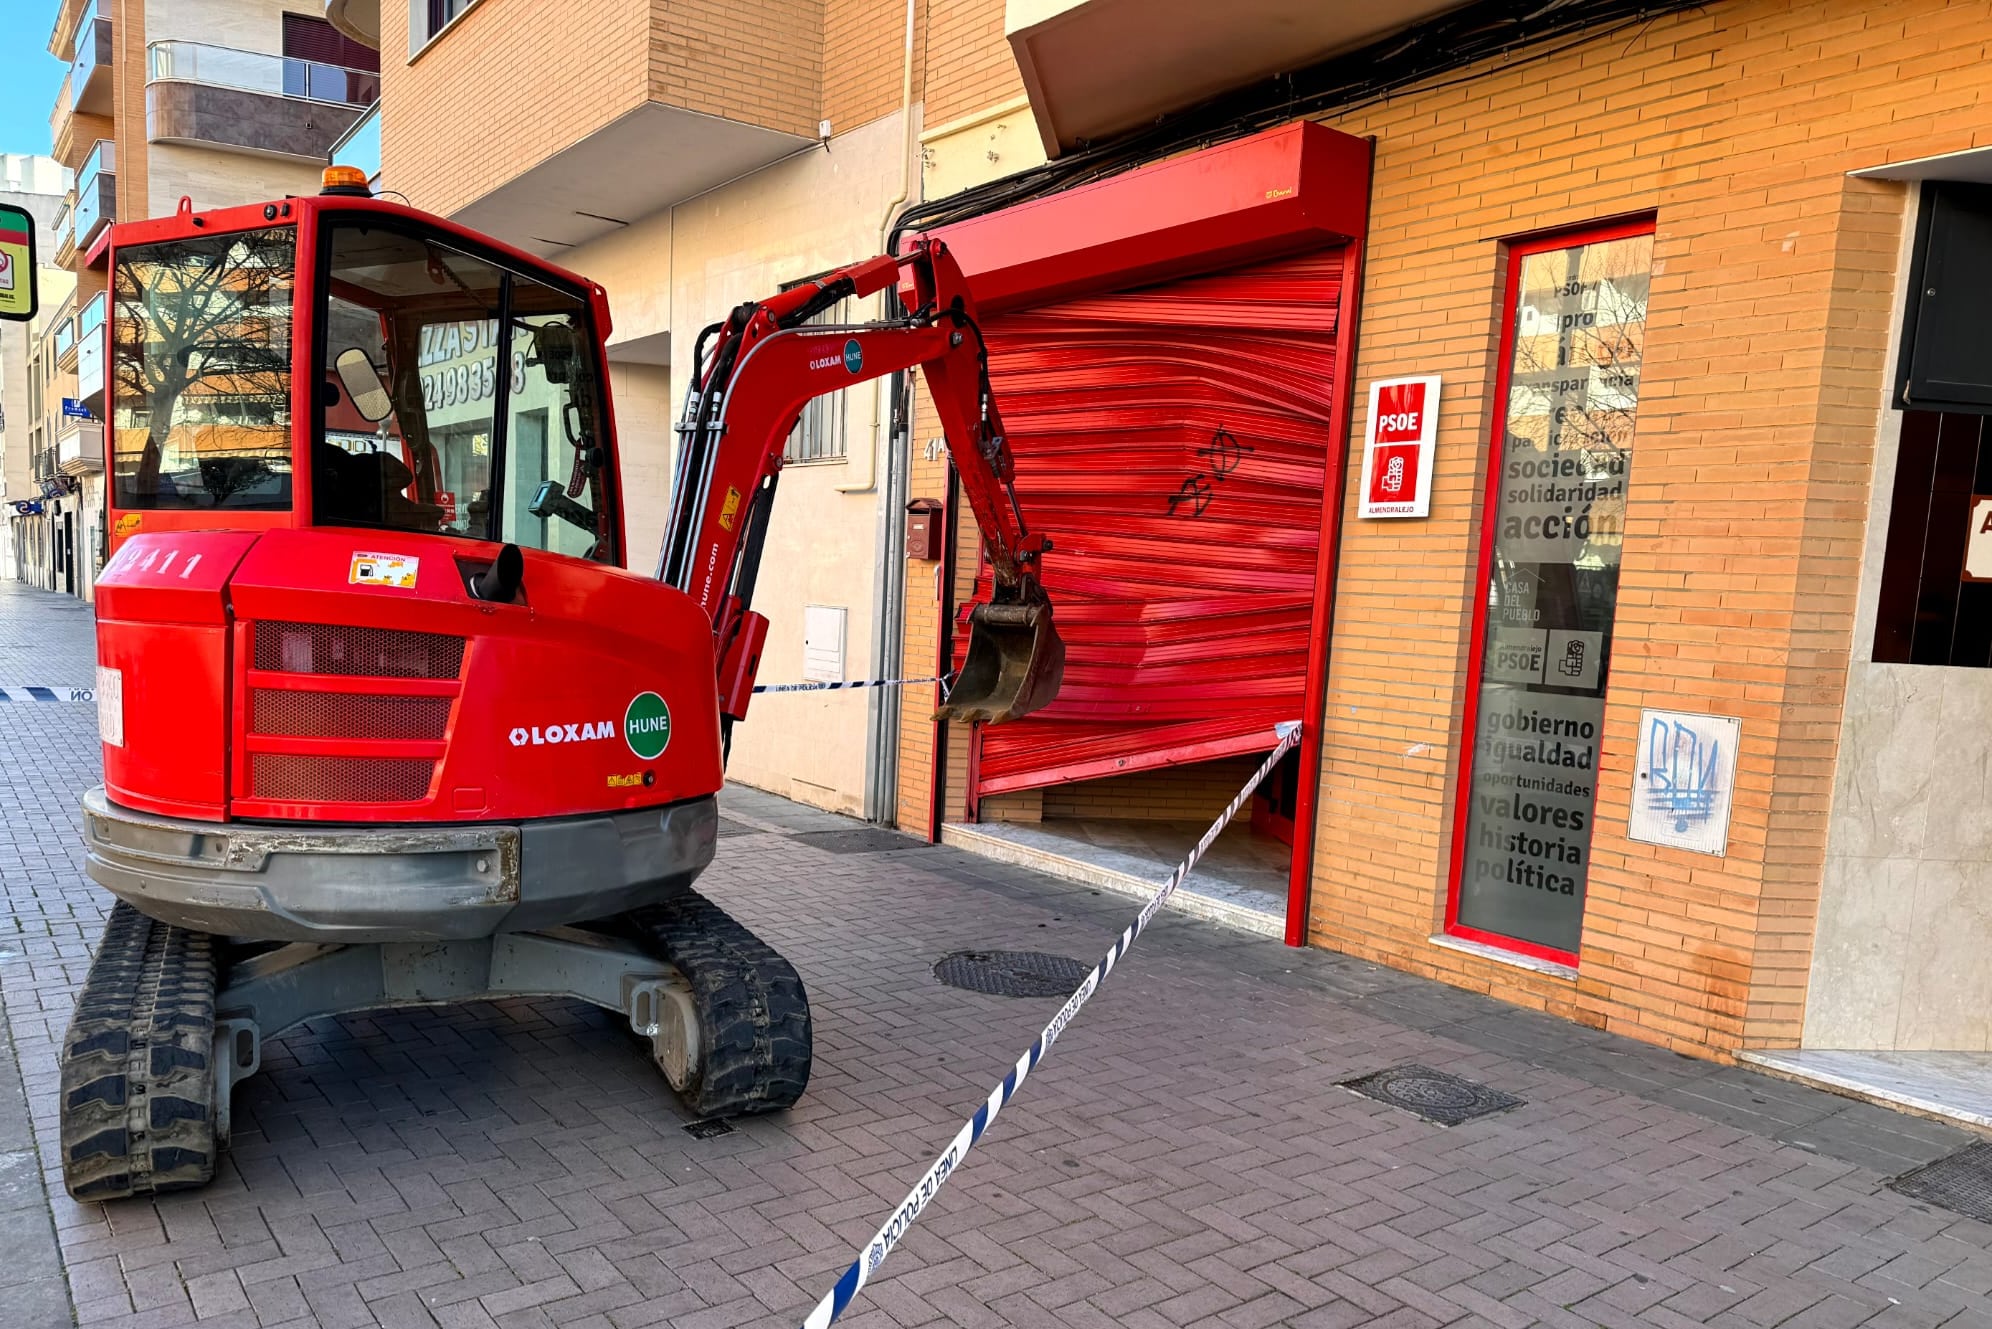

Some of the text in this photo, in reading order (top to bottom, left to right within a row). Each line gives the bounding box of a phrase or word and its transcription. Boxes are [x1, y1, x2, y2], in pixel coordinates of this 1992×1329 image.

[816, 356, 841, 368] LOXAM
[846, 352, 861, 361] HUNE
[1379, 412, 1418, 432] PSOE
[1507, 481, 1622, 504] solidaridad
[1368, 506, 1414, 514] ALMENDRALEJO
[1504, 504, 1617, 539] acción
[371, 554, 406, 562] ATENCIÓN
[1505, 582, 1530, 595] CASA
[1504, 595, 1521, 607] DEL
[1502, 608, 1540, 621] PUEBLO
[1497, 652, 1540, 671] PSOE
[531, 721, 616, 745] LOXAM
[629, 716, 668, 735] HUNE
[1487, 708, 1594, 739] gobierno
[1484, 735, 1593, 770] igualdad
[1483, 772, 1591, 798] oportunidades
[1480, 793, 1585, 831] valores
[1479, 822, 1582, 864] historia
[1474, 858, 1575, 896] política
[920, 1178, 933, 1207] DE
